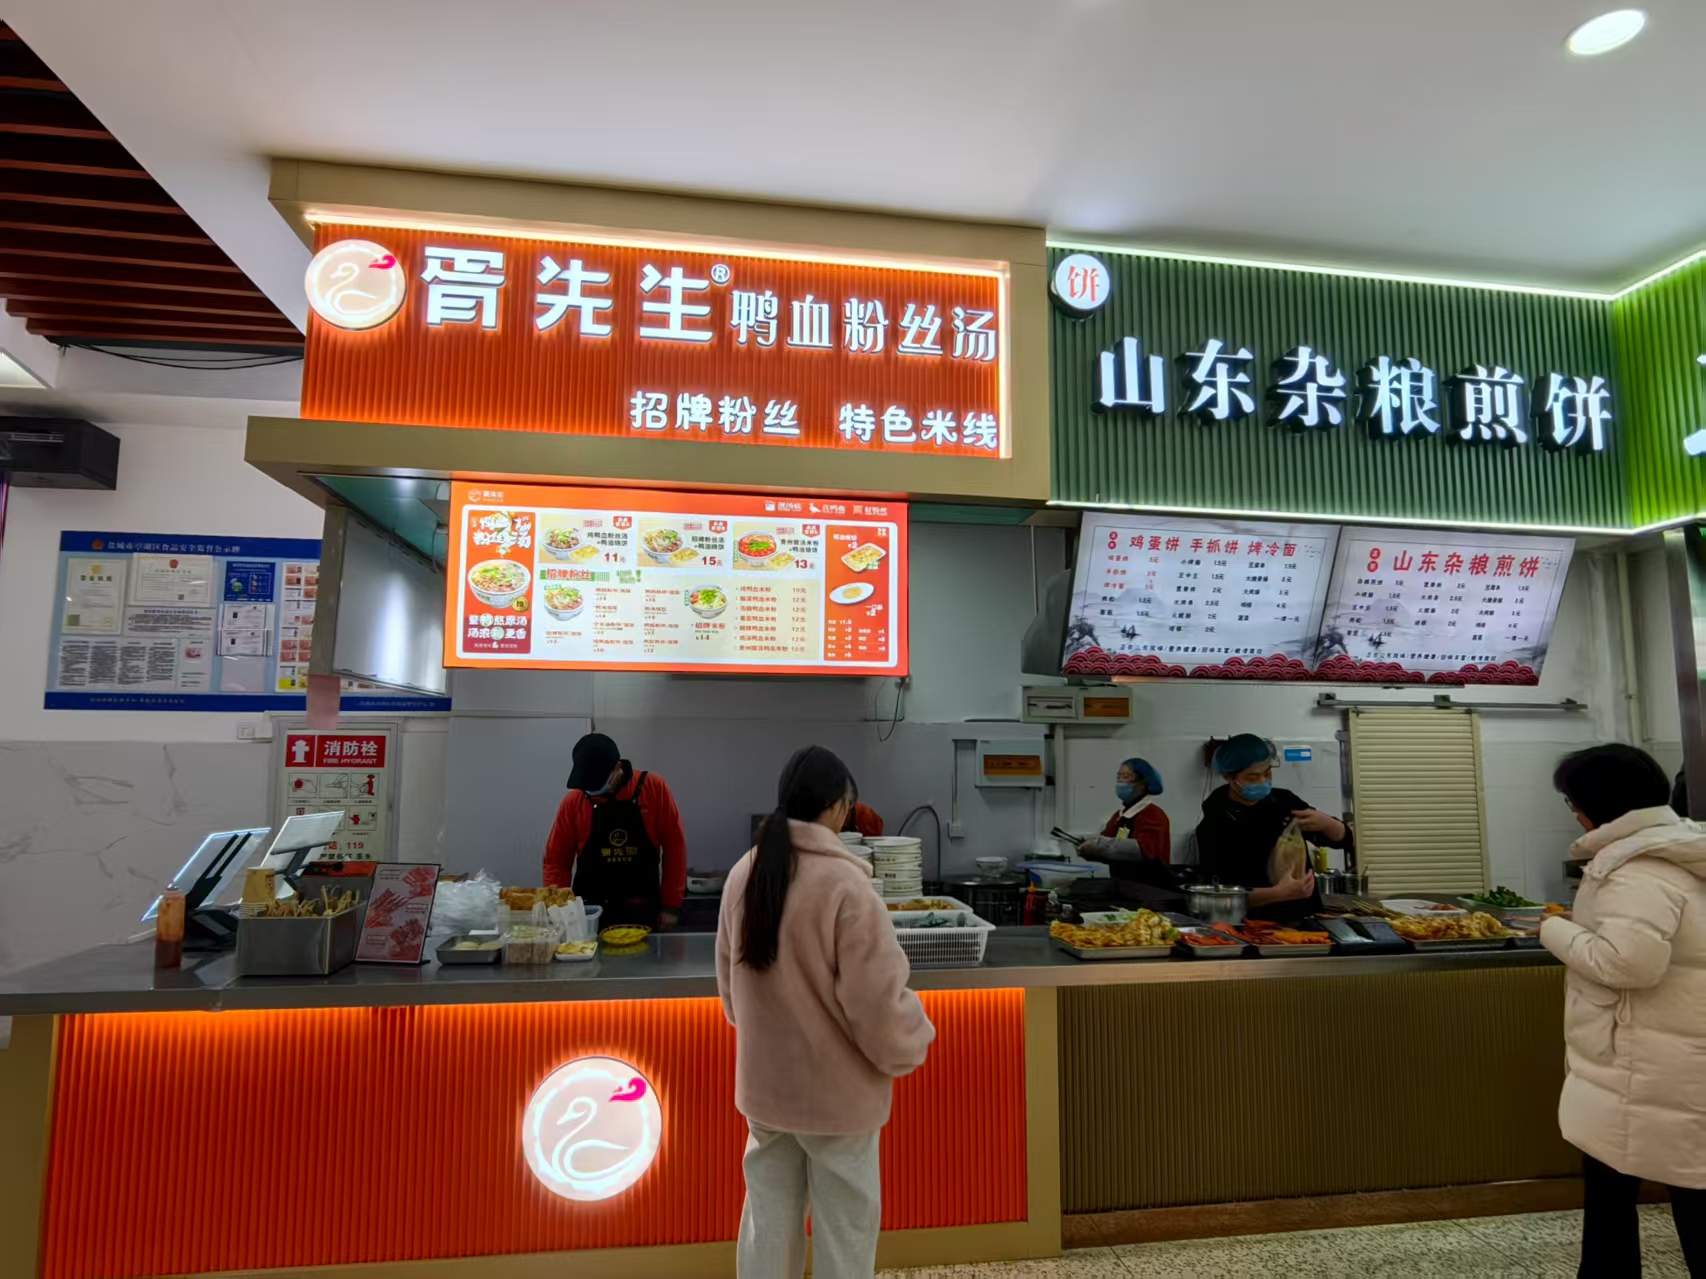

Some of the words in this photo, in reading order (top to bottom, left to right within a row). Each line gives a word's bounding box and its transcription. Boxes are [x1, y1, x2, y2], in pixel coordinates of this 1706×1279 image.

[1067, 265, 1100, 302] 饼
[730, 289, 997, 362] 鸭血粉丝汤
[1099, 335, 1613, 452] 山东杂粮煎饼
[630, 390, 801, 436] 招牌粉丝
[838, 402, 998, 450] 特色米线
[1129, 535, 1180, 552] 鸡蛋饼
[1190, 538, 1239, 555] 手抓饼
[1247, 541, 1298, 558] 烤冷面
[1393, 550, 1539, 578] 山东杂粮煎饼
[323, 740, 379, 757] 消防栓
